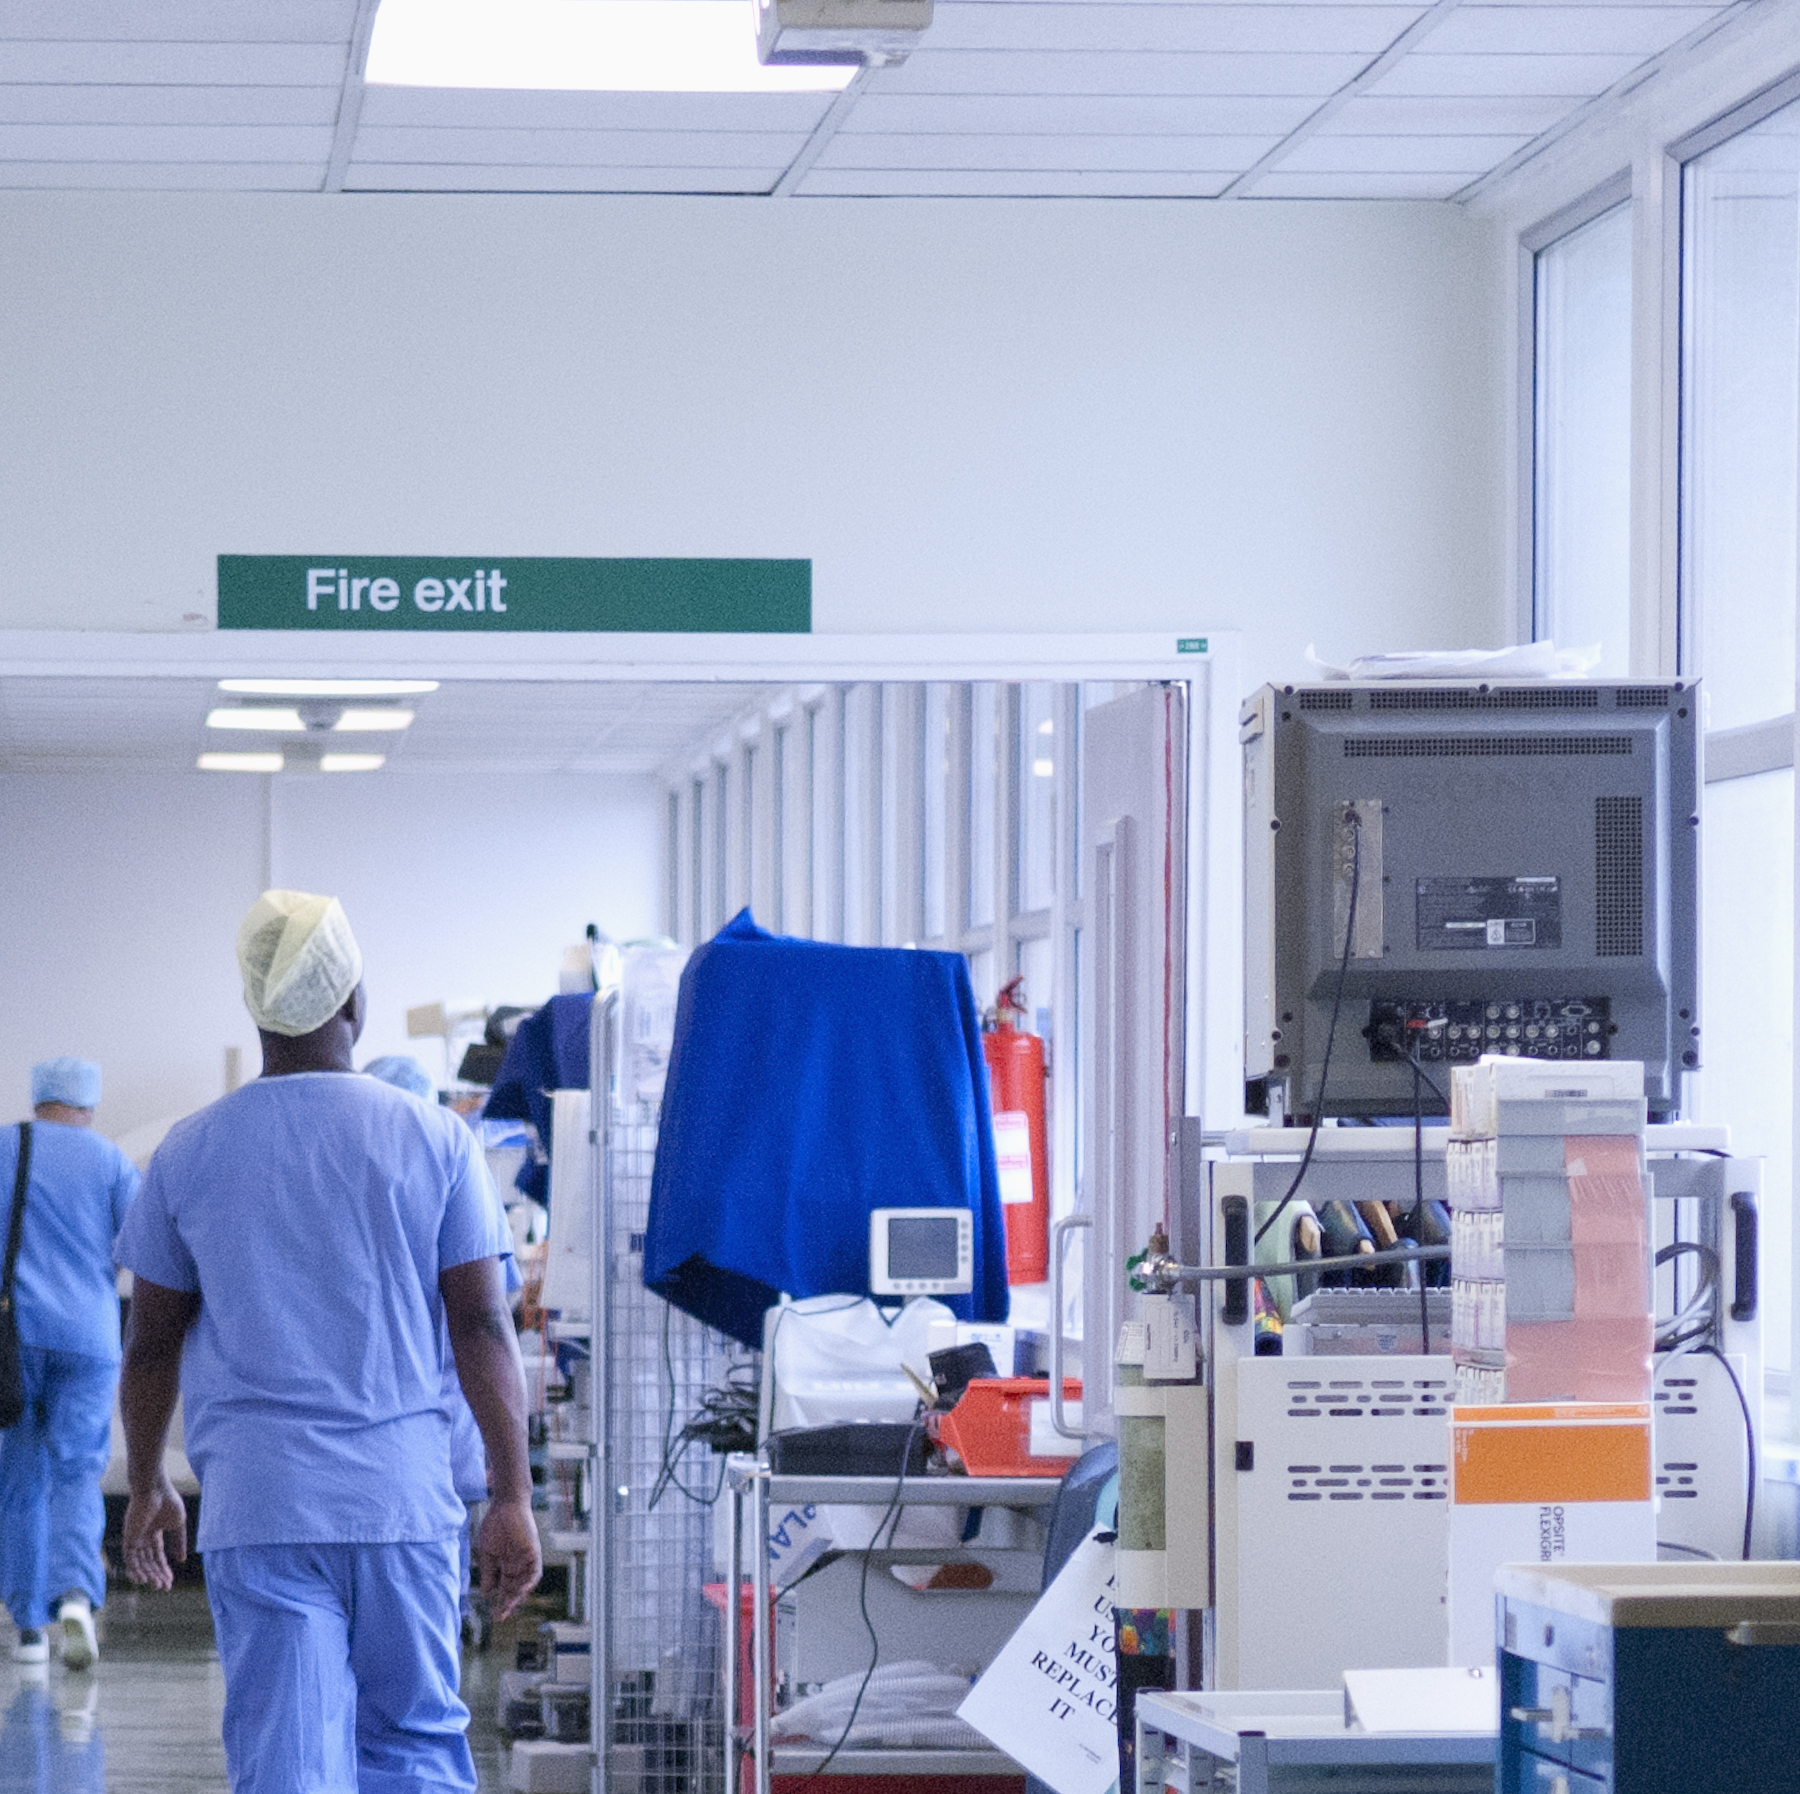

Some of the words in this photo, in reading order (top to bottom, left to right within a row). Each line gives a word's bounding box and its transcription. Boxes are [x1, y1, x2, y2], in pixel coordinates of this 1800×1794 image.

[306, 568, 400, 612] Fire
[414, 569, 508, 613] exit
[1540, 1506, 1552, 1562] FLEXIGRI
[1553, 1506, 1566, 1553] OPSITE
[1030, 1650, 1119, 1726] REPLACE
[1048, 1697, 1076, 1721] IT
